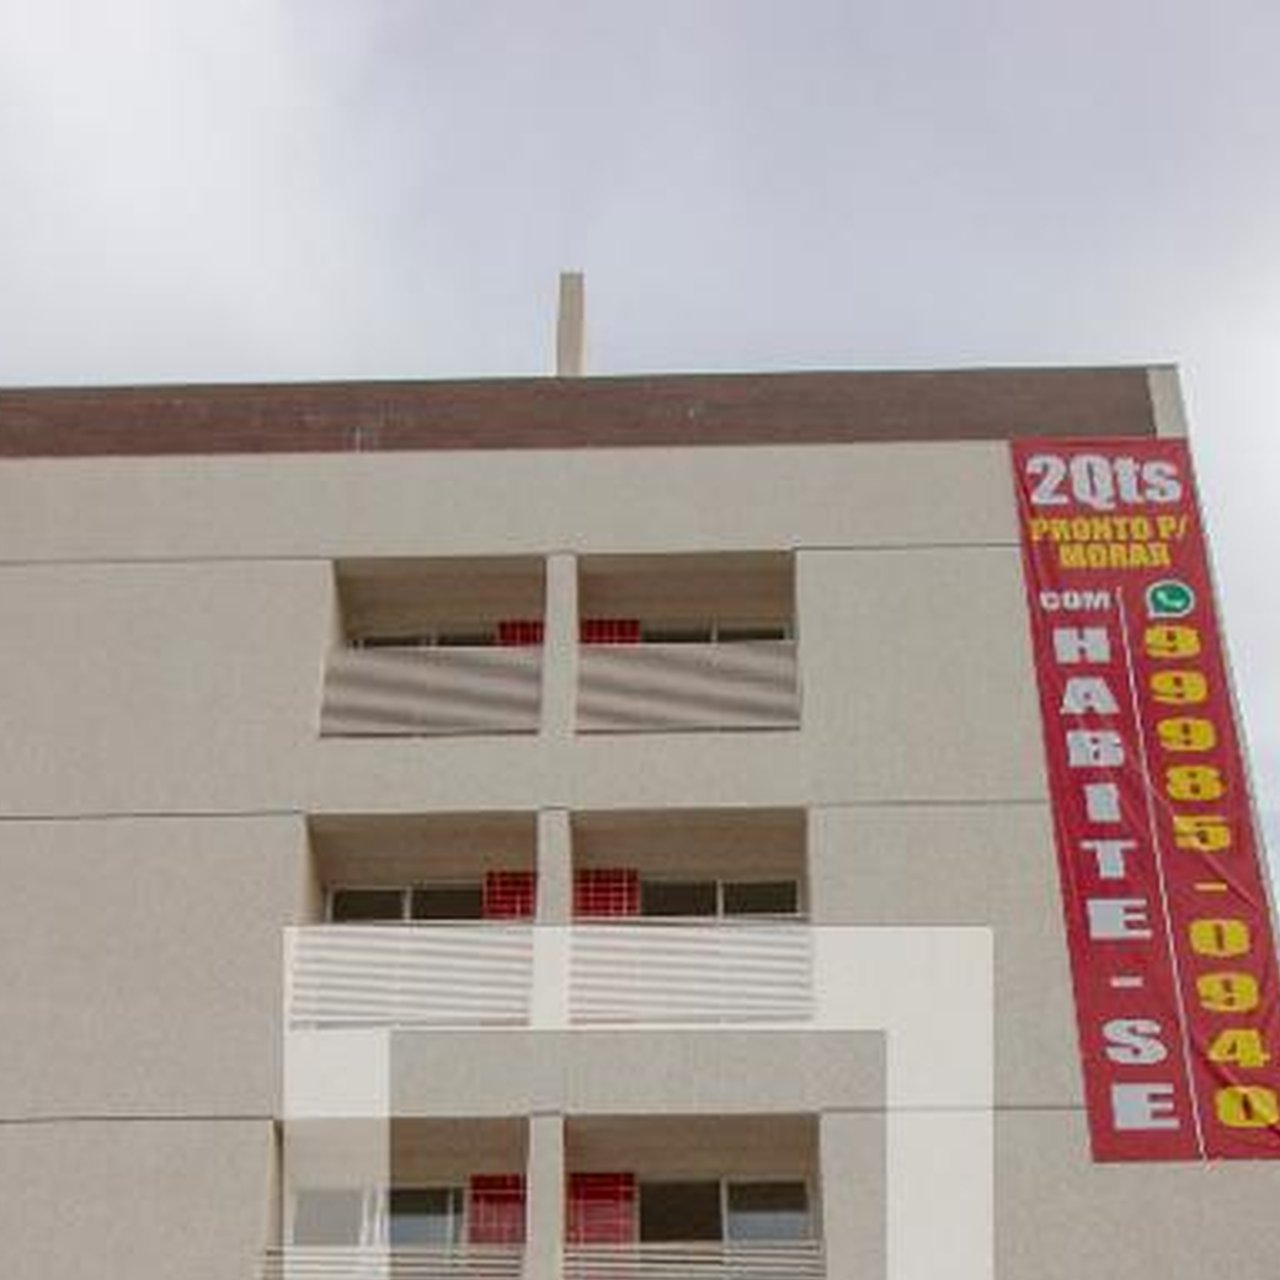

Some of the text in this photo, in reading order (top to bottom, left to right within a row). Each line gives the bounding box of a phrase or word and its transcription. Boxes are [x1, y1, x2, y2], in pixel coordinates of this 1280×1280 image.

[1026, 453, 1183, 510] 2Qts
[1030, 516, 1150, 542] PRONTO
[1058, 542, 1172, 569] MORAR
